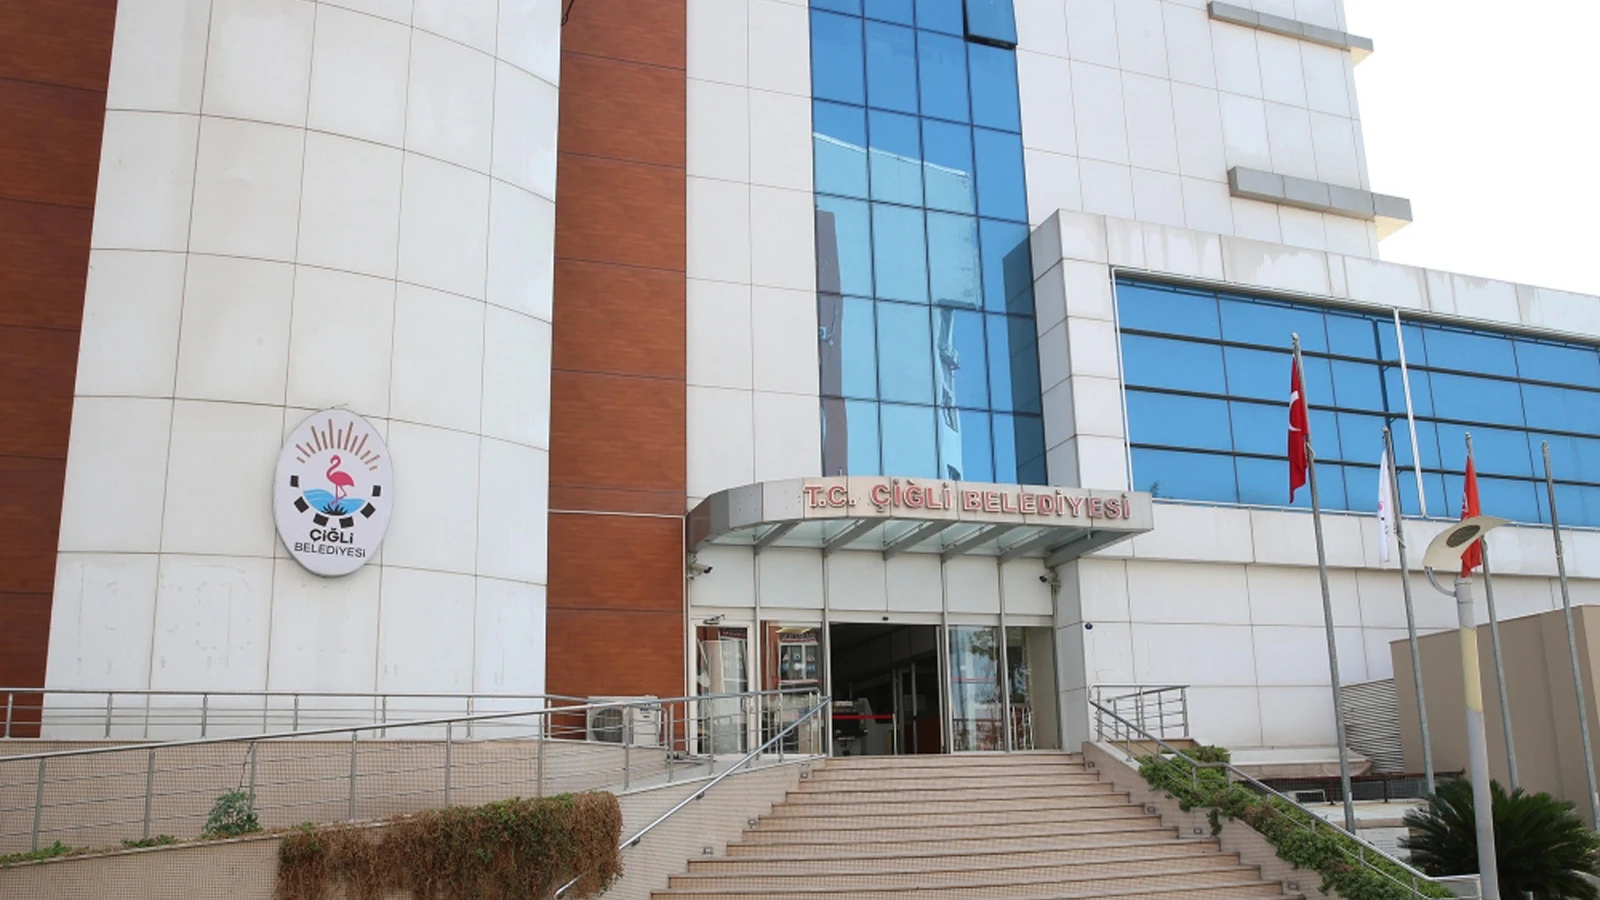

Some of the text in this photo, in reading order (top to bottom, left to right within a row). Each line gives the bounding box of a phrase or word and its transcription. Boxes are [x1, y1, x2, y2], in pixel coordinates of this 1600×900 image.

[803, 479, 1131, 519] T.C. ÇİĞLİ BELEDİYESİ
[309, 528, 354, 544] ÇİĞLİ
[294, 542, 366, 558] BELEDİYESİ
